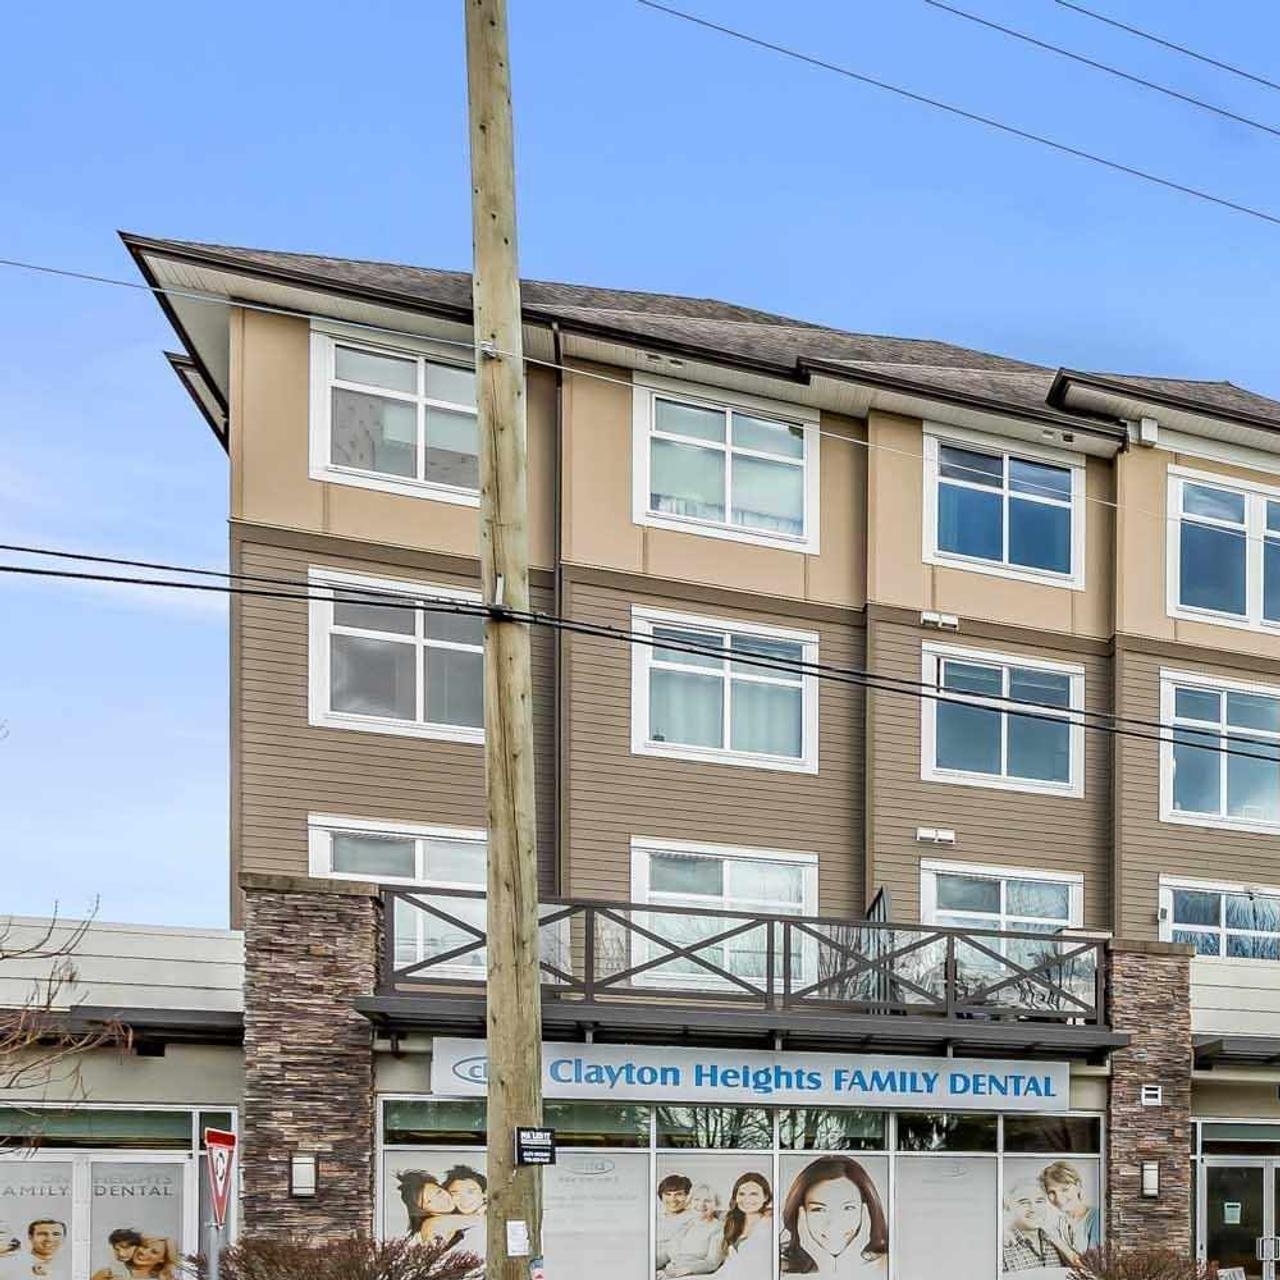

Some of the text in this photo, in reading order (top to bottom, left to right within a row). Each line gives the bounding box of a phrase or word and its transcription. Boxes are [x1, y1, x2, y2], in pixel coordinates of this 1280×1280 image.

[549, 1058, 1058, 1098] Clayton Heights FAMILY DENTAL
[1, 1185, 174, 1197] AMILY DENTAL
